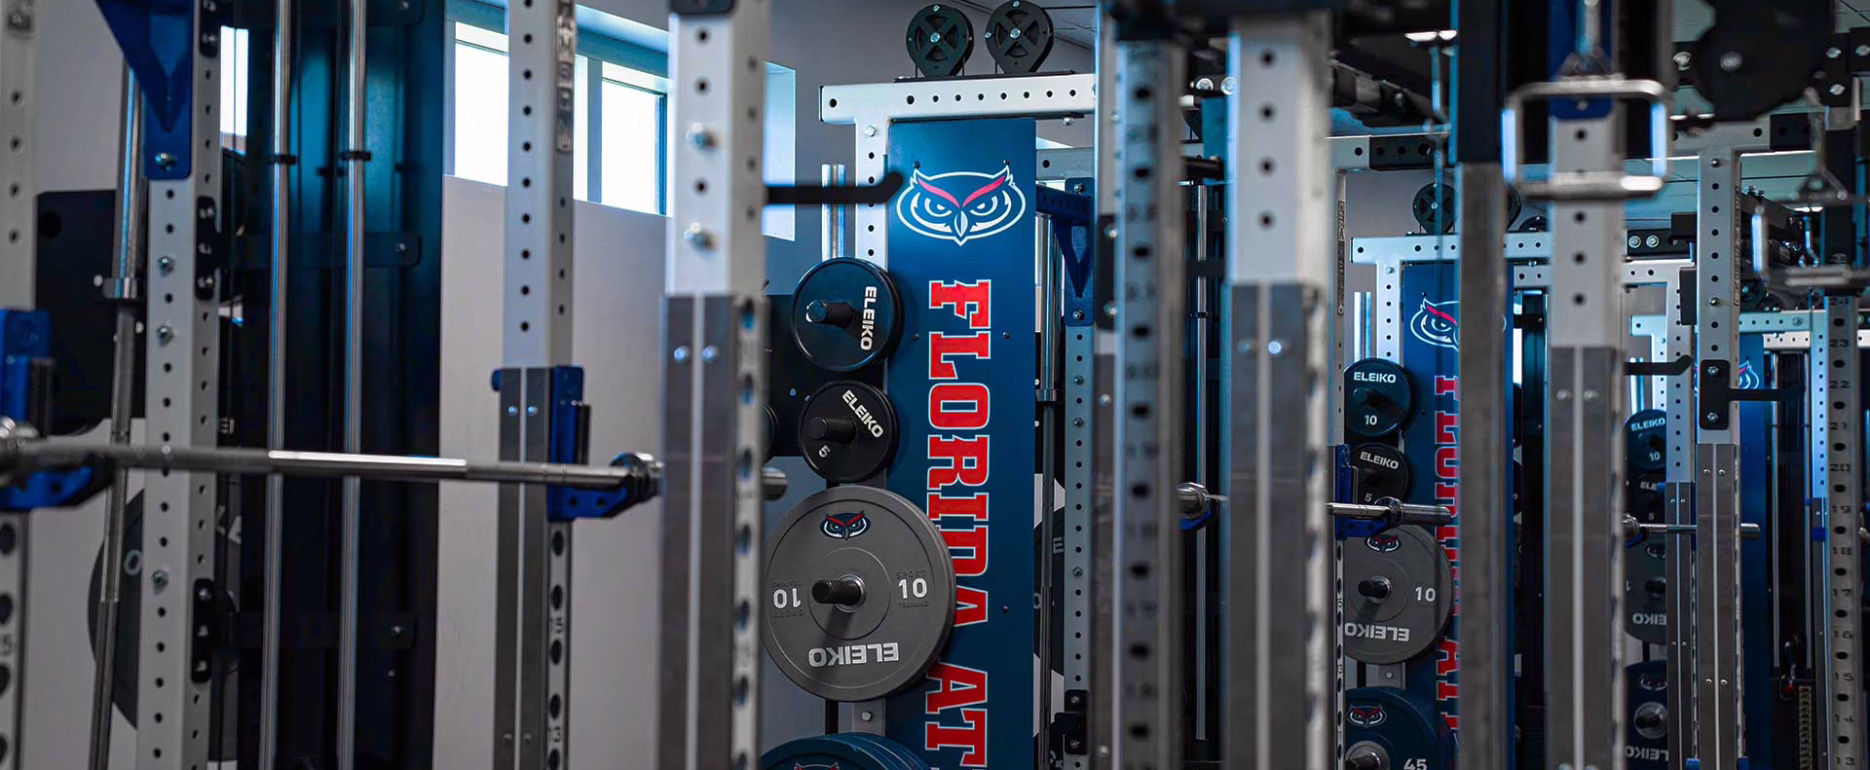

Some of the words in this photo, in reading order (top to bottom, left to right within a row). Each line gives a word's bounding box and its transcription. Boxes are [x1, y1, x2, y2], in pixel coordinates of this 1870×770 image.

[860, 286, 877, 351] ELEIKO
[1353, 371, 1397, 384] ELEIKO
[842, 389, 884, 438] ELEIKO
[1364, 415, 1378, 426] 10
[1631, 417, 1666, 432] ELEIKO
[818, 445, 831, 458] 5
[927, 278, 991, 627] FLORIDA
[1649, 451, 1661, 462] 10
[1360, 451, 1399, 470] ELEIKO
[1640, 481, 1658, 491] ELE
[1365, 493, 1372, 502] 5
[898, 578, 928, 599] 10
[1415, 586, 1436, 602] 10
[773, 587, 802, 609] 10
[1632, 613, 1667, 626] EIKO
[1345, 622, 1410, 642] ELEIKO
[808, 642, 899, 668] ELEIKO
[925, 657, 988, 770] AT
[1625, 745, 1669, 762] LEIKO
[1403, 758, 1428, 770] 45
